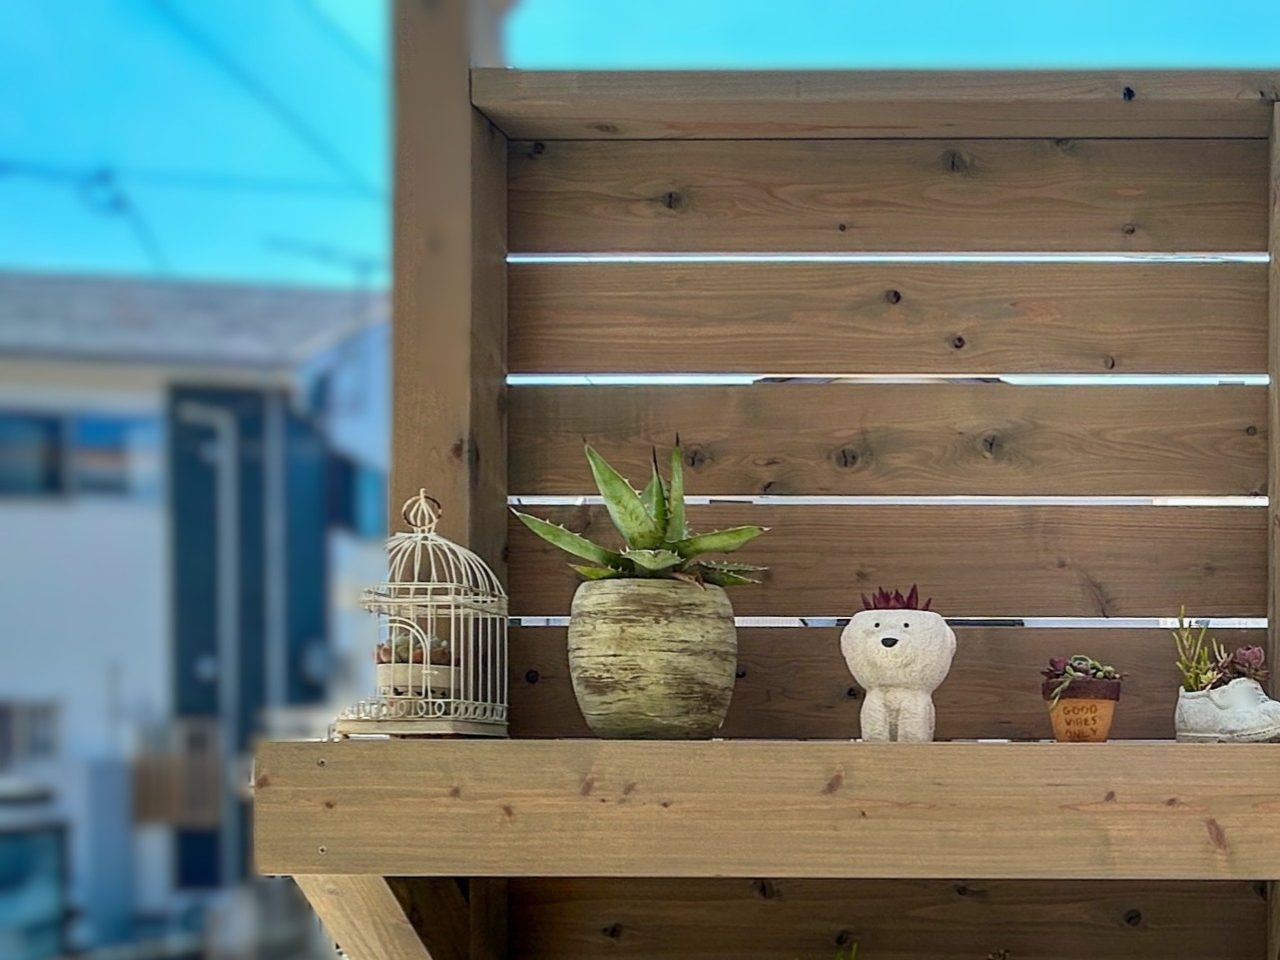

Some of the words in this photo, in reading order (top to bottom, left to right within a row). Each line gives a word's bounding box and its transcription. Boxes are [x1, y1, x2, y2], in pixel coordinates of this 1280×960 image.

[1062, 704, 1098, 716] GOOD
[1065, 716, 1097, 727] VIBES
[1065, 727, 1098, 739] ONLY
